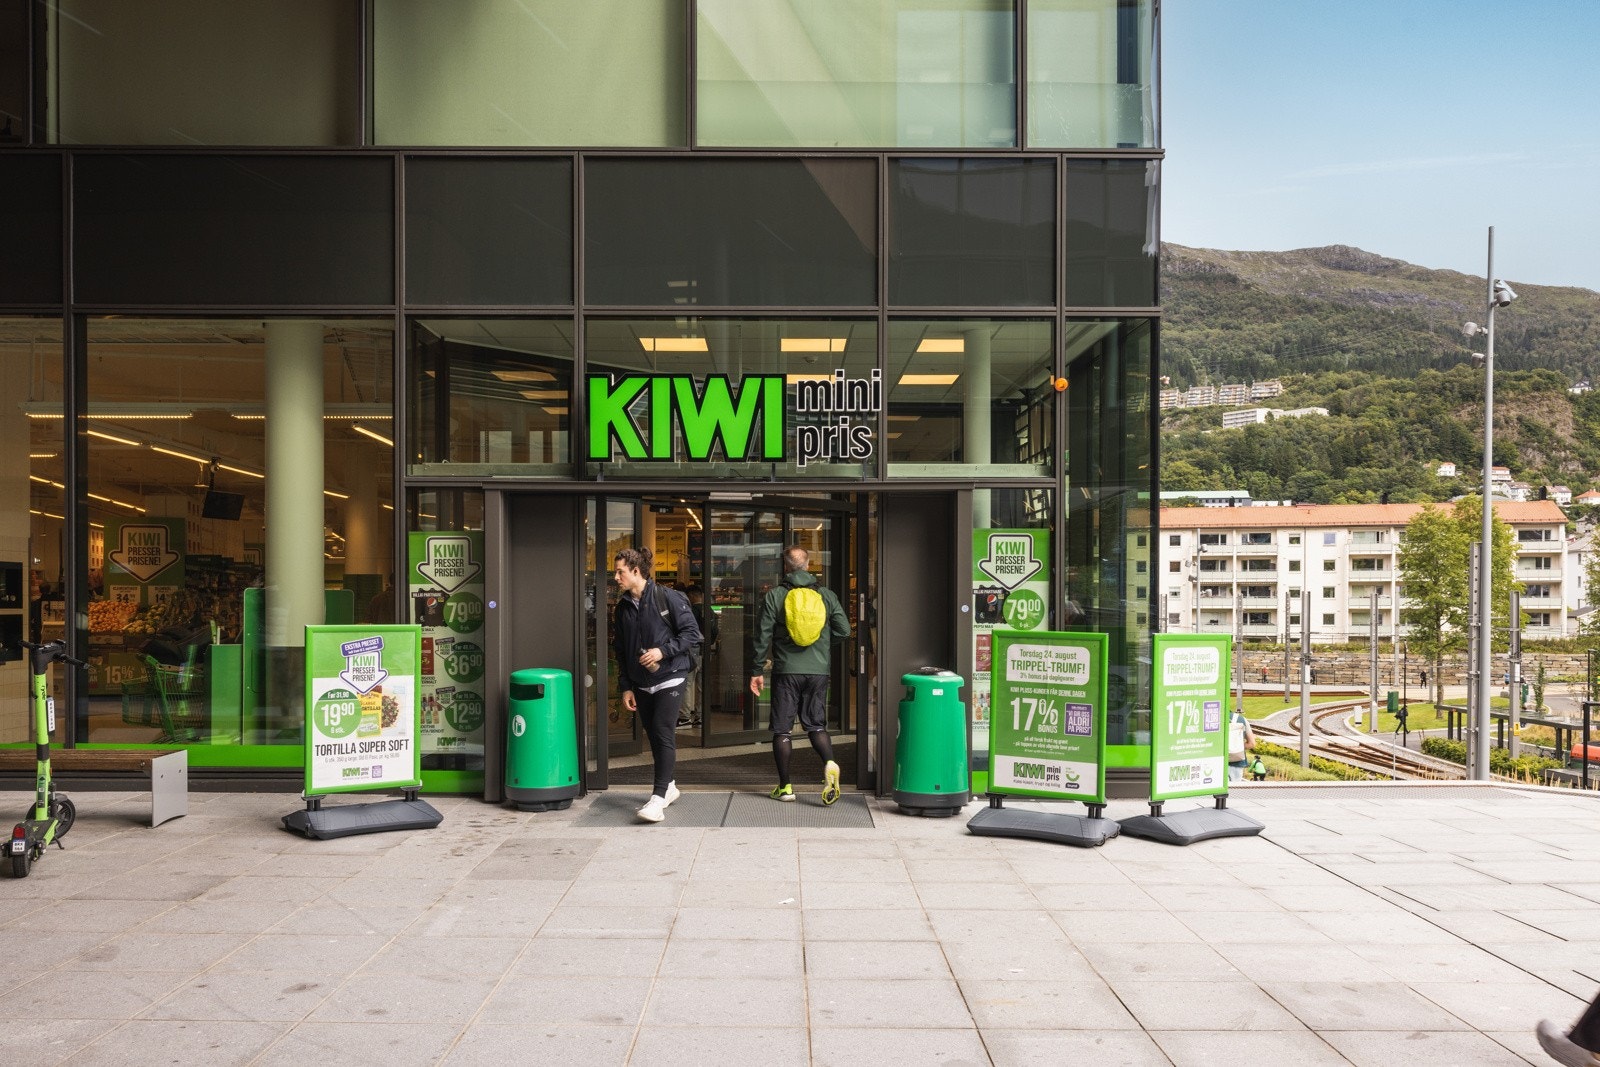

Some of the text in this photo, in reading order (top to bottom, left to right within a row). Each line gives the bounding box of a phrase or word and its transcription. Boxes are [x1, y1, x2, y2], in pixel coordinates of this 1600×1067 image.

[797, 369, 882, 411] mini
[587, 374, 786, 461] KIWI
[797, 416, 873, 467] pris
[128, 532, 160, 545] KIWI
[128, 547, 160, 556] PRESSER
[434, 545, 464, 557] KIWI
[996, 542, 1025, 554] KIWI
[128, 557, 161, 566] PRISENE!
[434, 559, 464, 567] PRESSER
[996, 556, 1025, 564] PRESSER
[434, 568, 464, 577] PRISENE!
[996, 565, 1025, 574] PRISENE!
[1020, 649, 1042, 659] Torsdag
[1055, 652, 1076, 660] august
[353, 656, 375, 666] KIWI
[1011, 660, 1085, 674] TRIPPEL-TRUMF!
[1167, 663, 1216, 674] TRIPPEL-TRUMF!
[1010, 697, 1058, 731] 17%
[1167, 700, 1200, 734] 17%
[1069, 716, 1090, 726] ALDRI
[1038, 724, 1058, 733] BONUS
[437, 737, 457, 746] KIWI
[315, 739, 409, 756] TORTILLA SUPER SOFT
[342, 767, 360, 777] KIWI
[1014, 762, 1045, 779] KIWI
[1169, 765, 1190, 781] KIWI
[1046, 773, 1060, 781] pris
